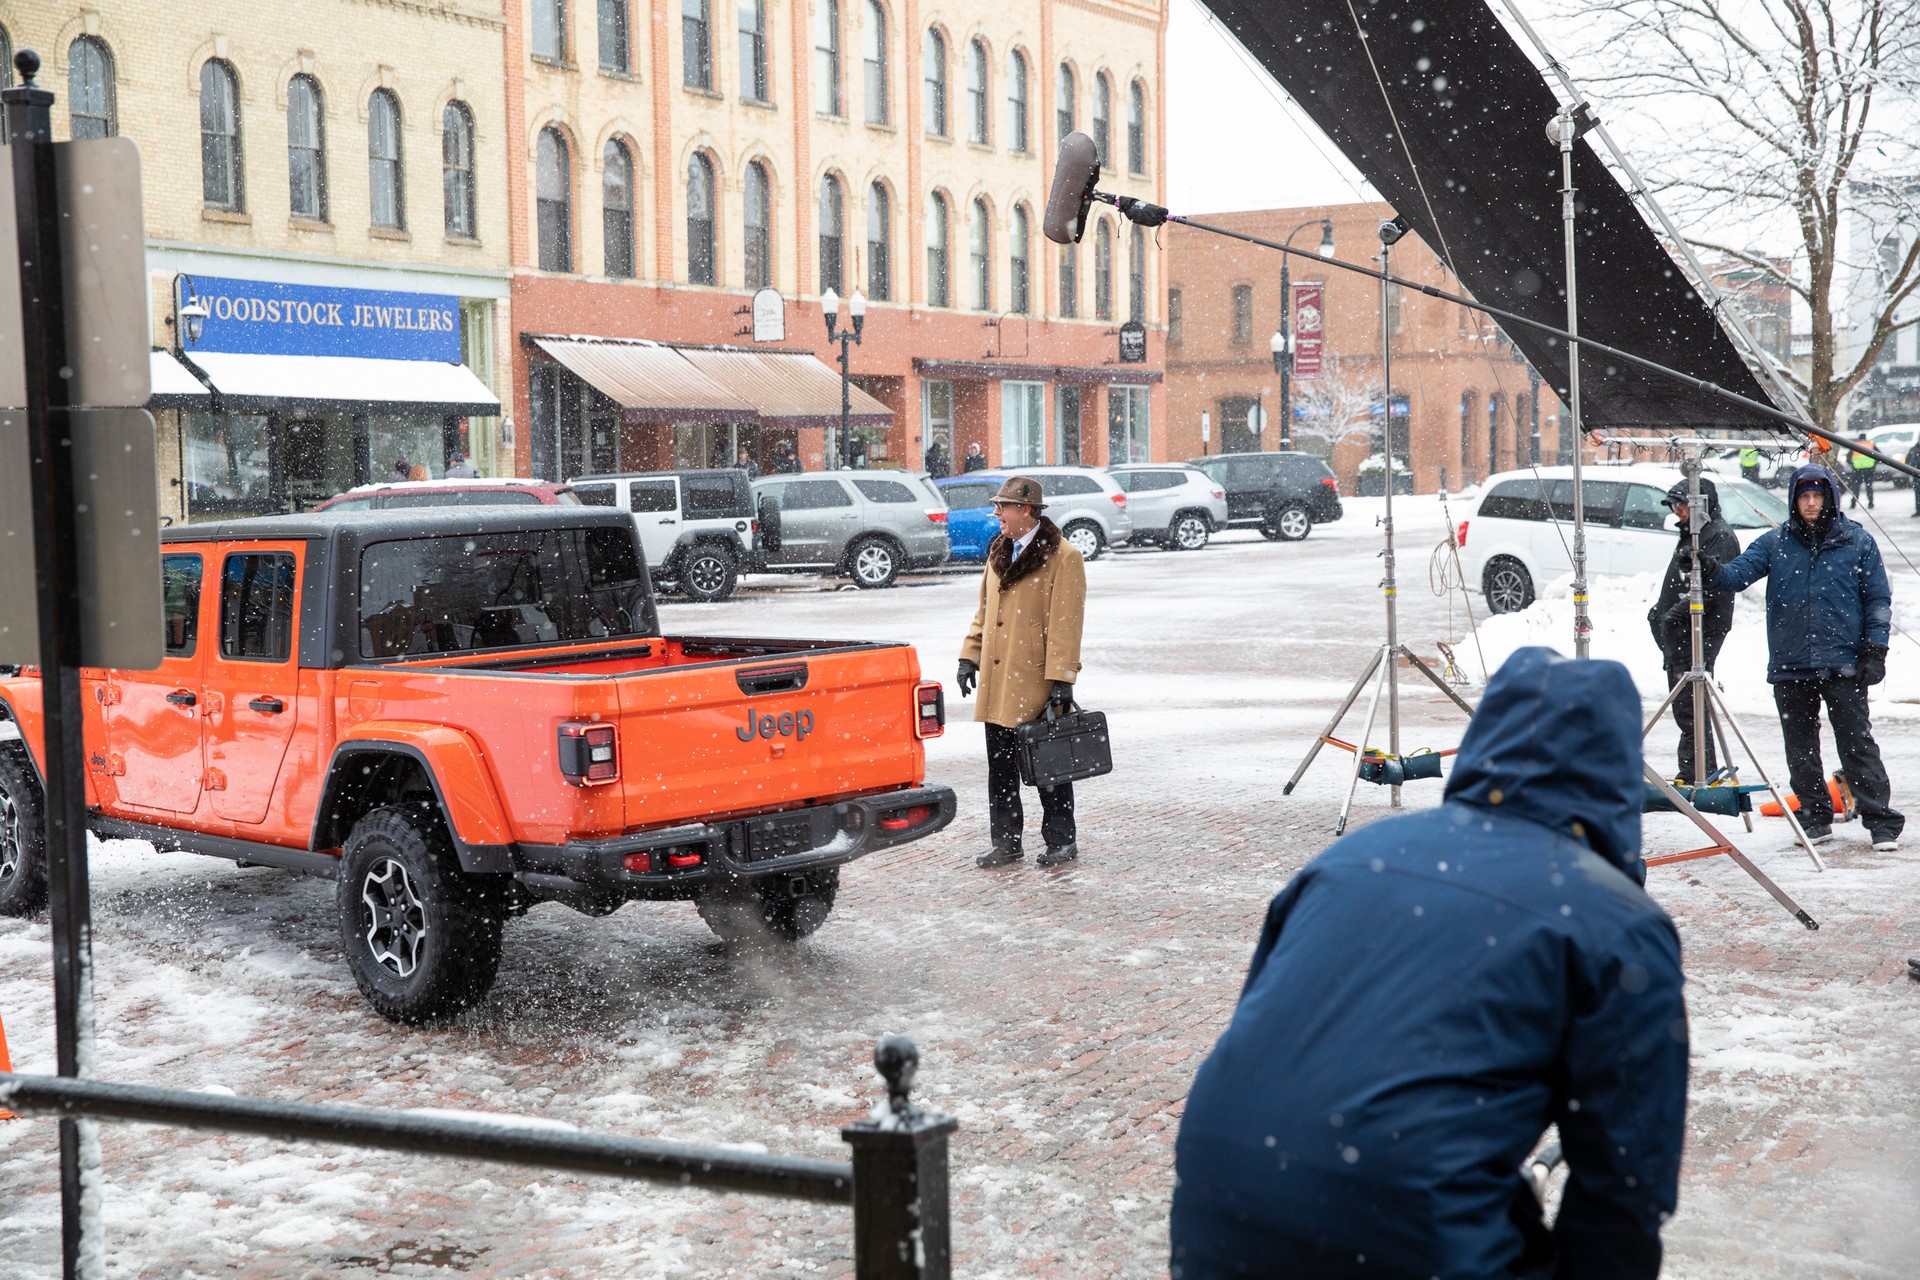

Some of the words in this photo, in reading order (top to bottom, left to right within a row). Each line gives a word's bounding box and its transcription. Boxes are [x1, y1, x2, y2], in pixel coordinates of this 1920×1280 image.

[193, 295, 344, 326] WOODSTOCK
[351, 304, 454, 332] JEWELERS
[736, 708, 815, 742] Jeep
